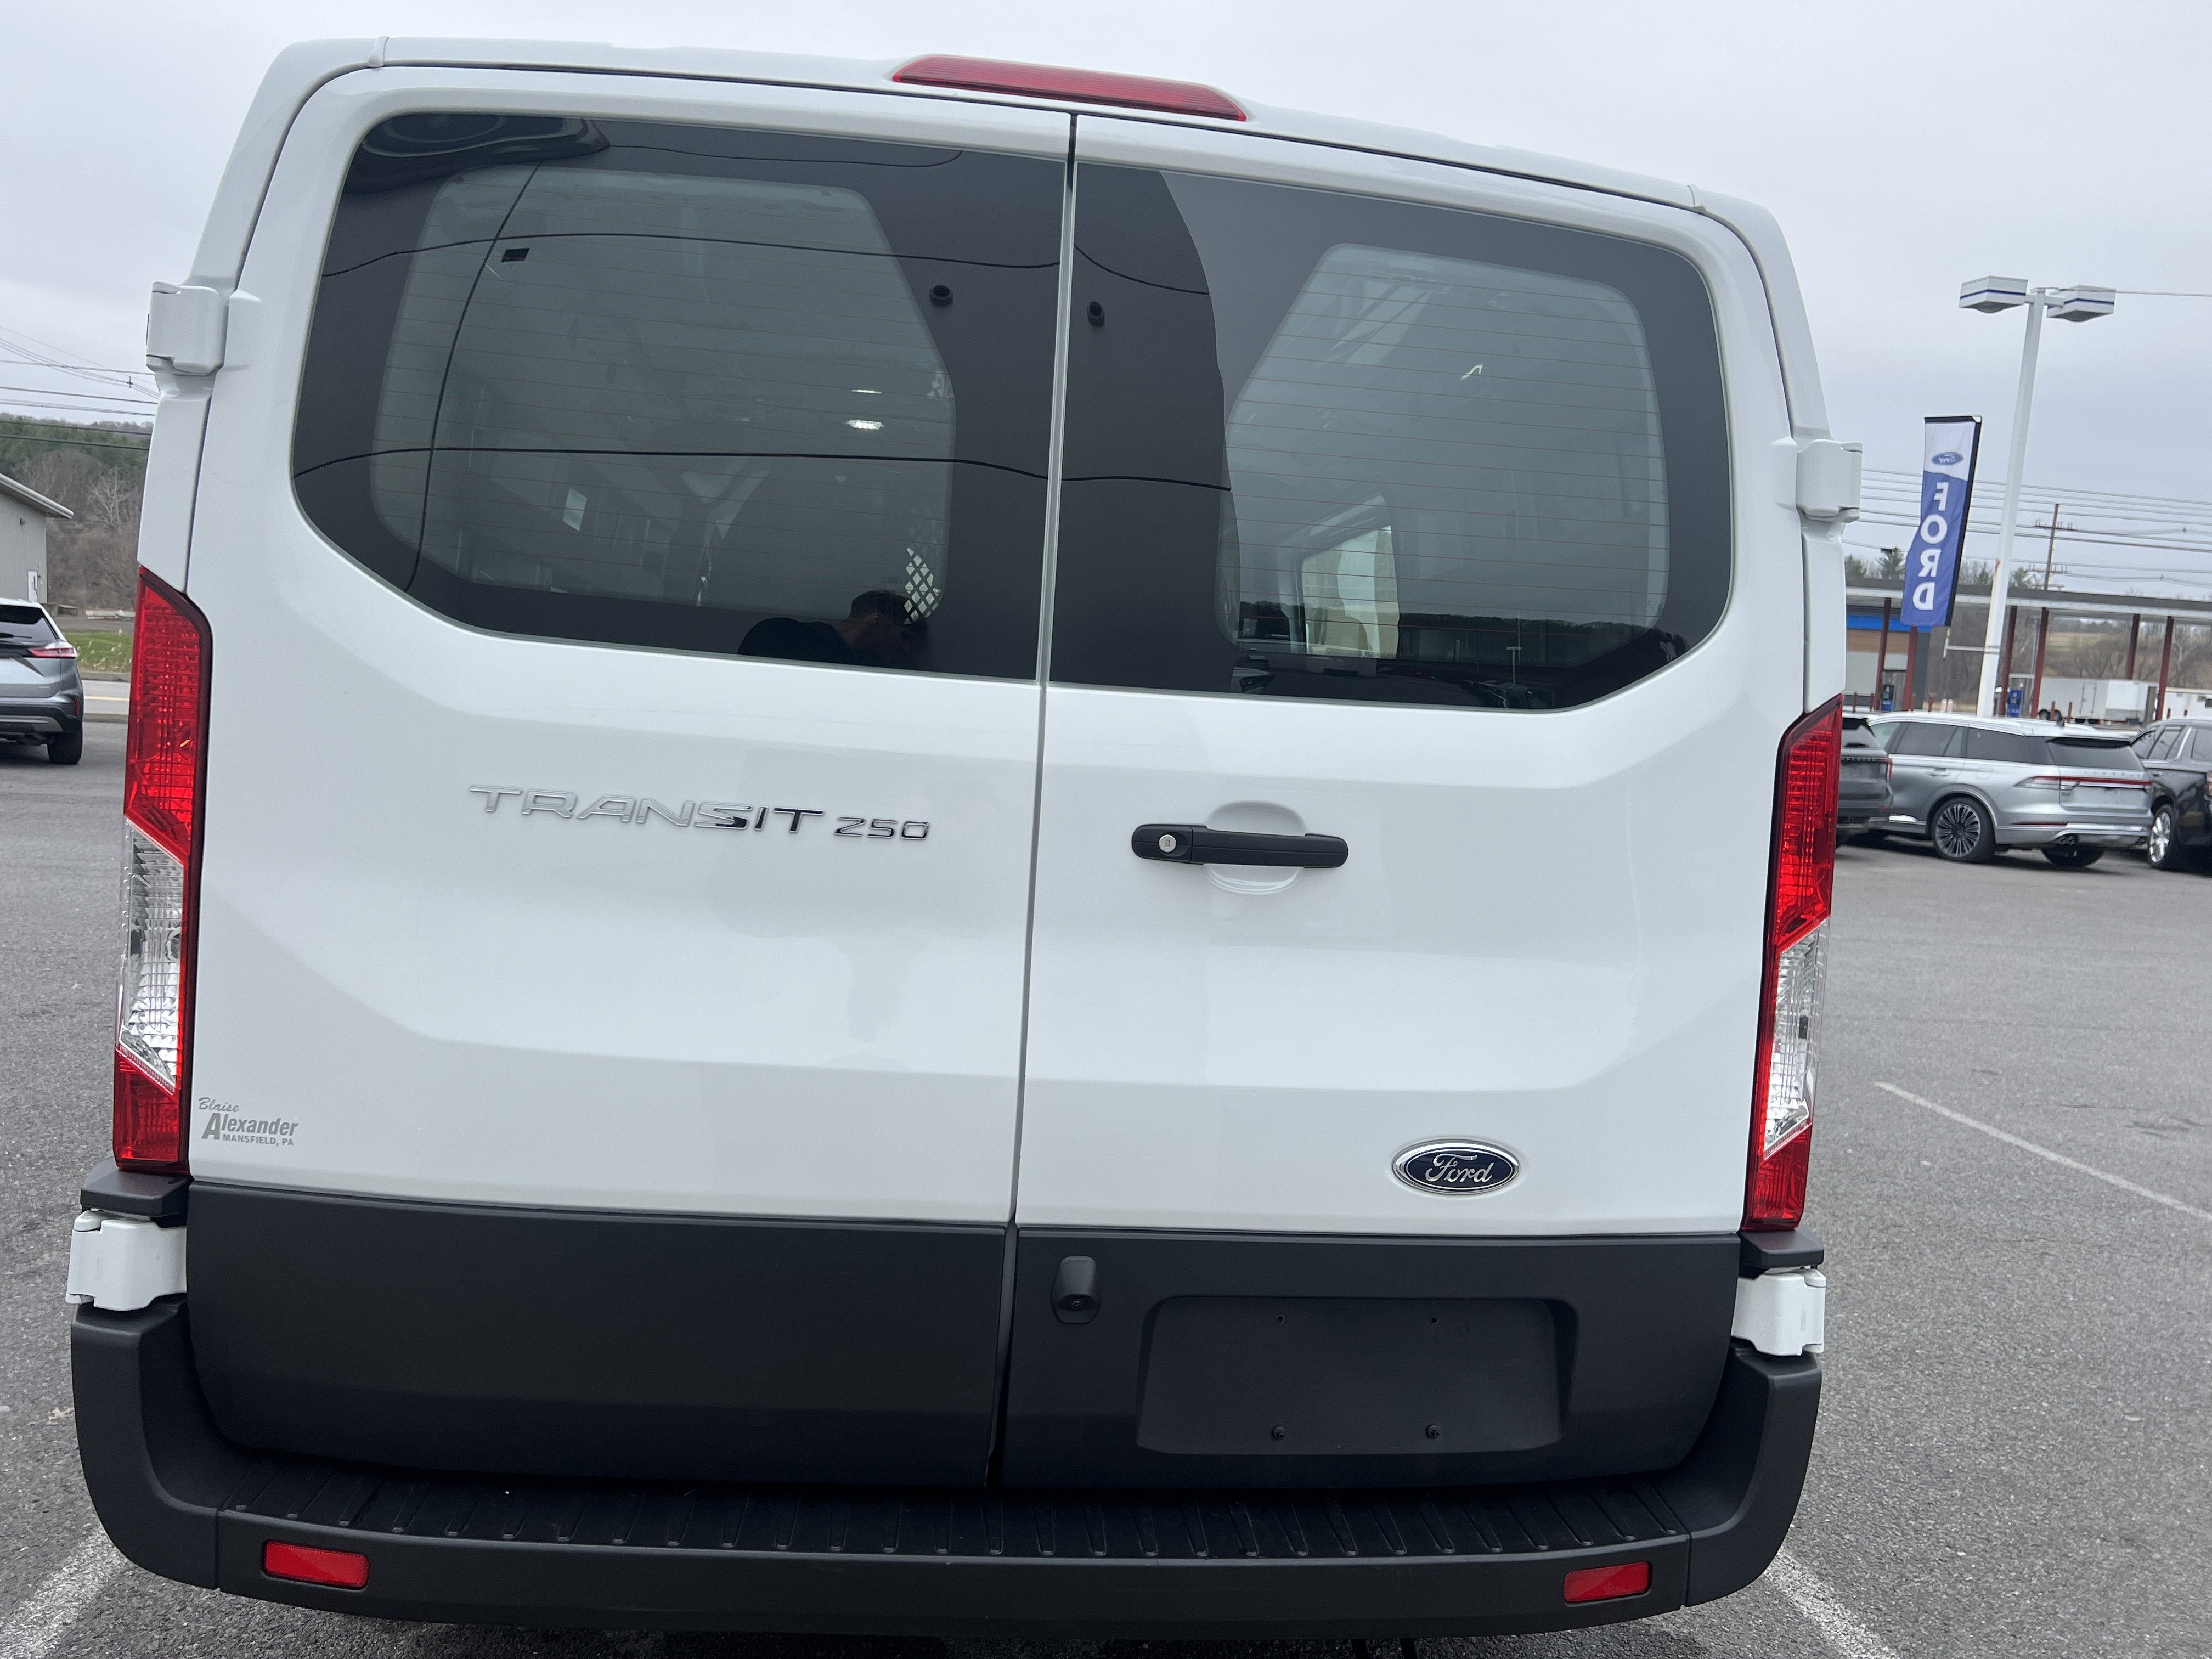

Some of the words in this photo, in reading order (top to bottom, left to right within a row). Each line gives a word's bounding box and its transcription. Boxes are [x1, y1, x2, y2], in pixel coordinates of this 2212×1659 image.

[469, 785, 825, 833] TRANSIT
[834, 816, 930, 840] 250
[198, 1097, 239, 1113] Blaise
[201, 1113, 299, 1140] Alexander
[223, 1133, 279, 1147] MANSFIELD,
[282, 1138, 294, 1146] PA
[1425, 1153, 1494, 1182] Ford
